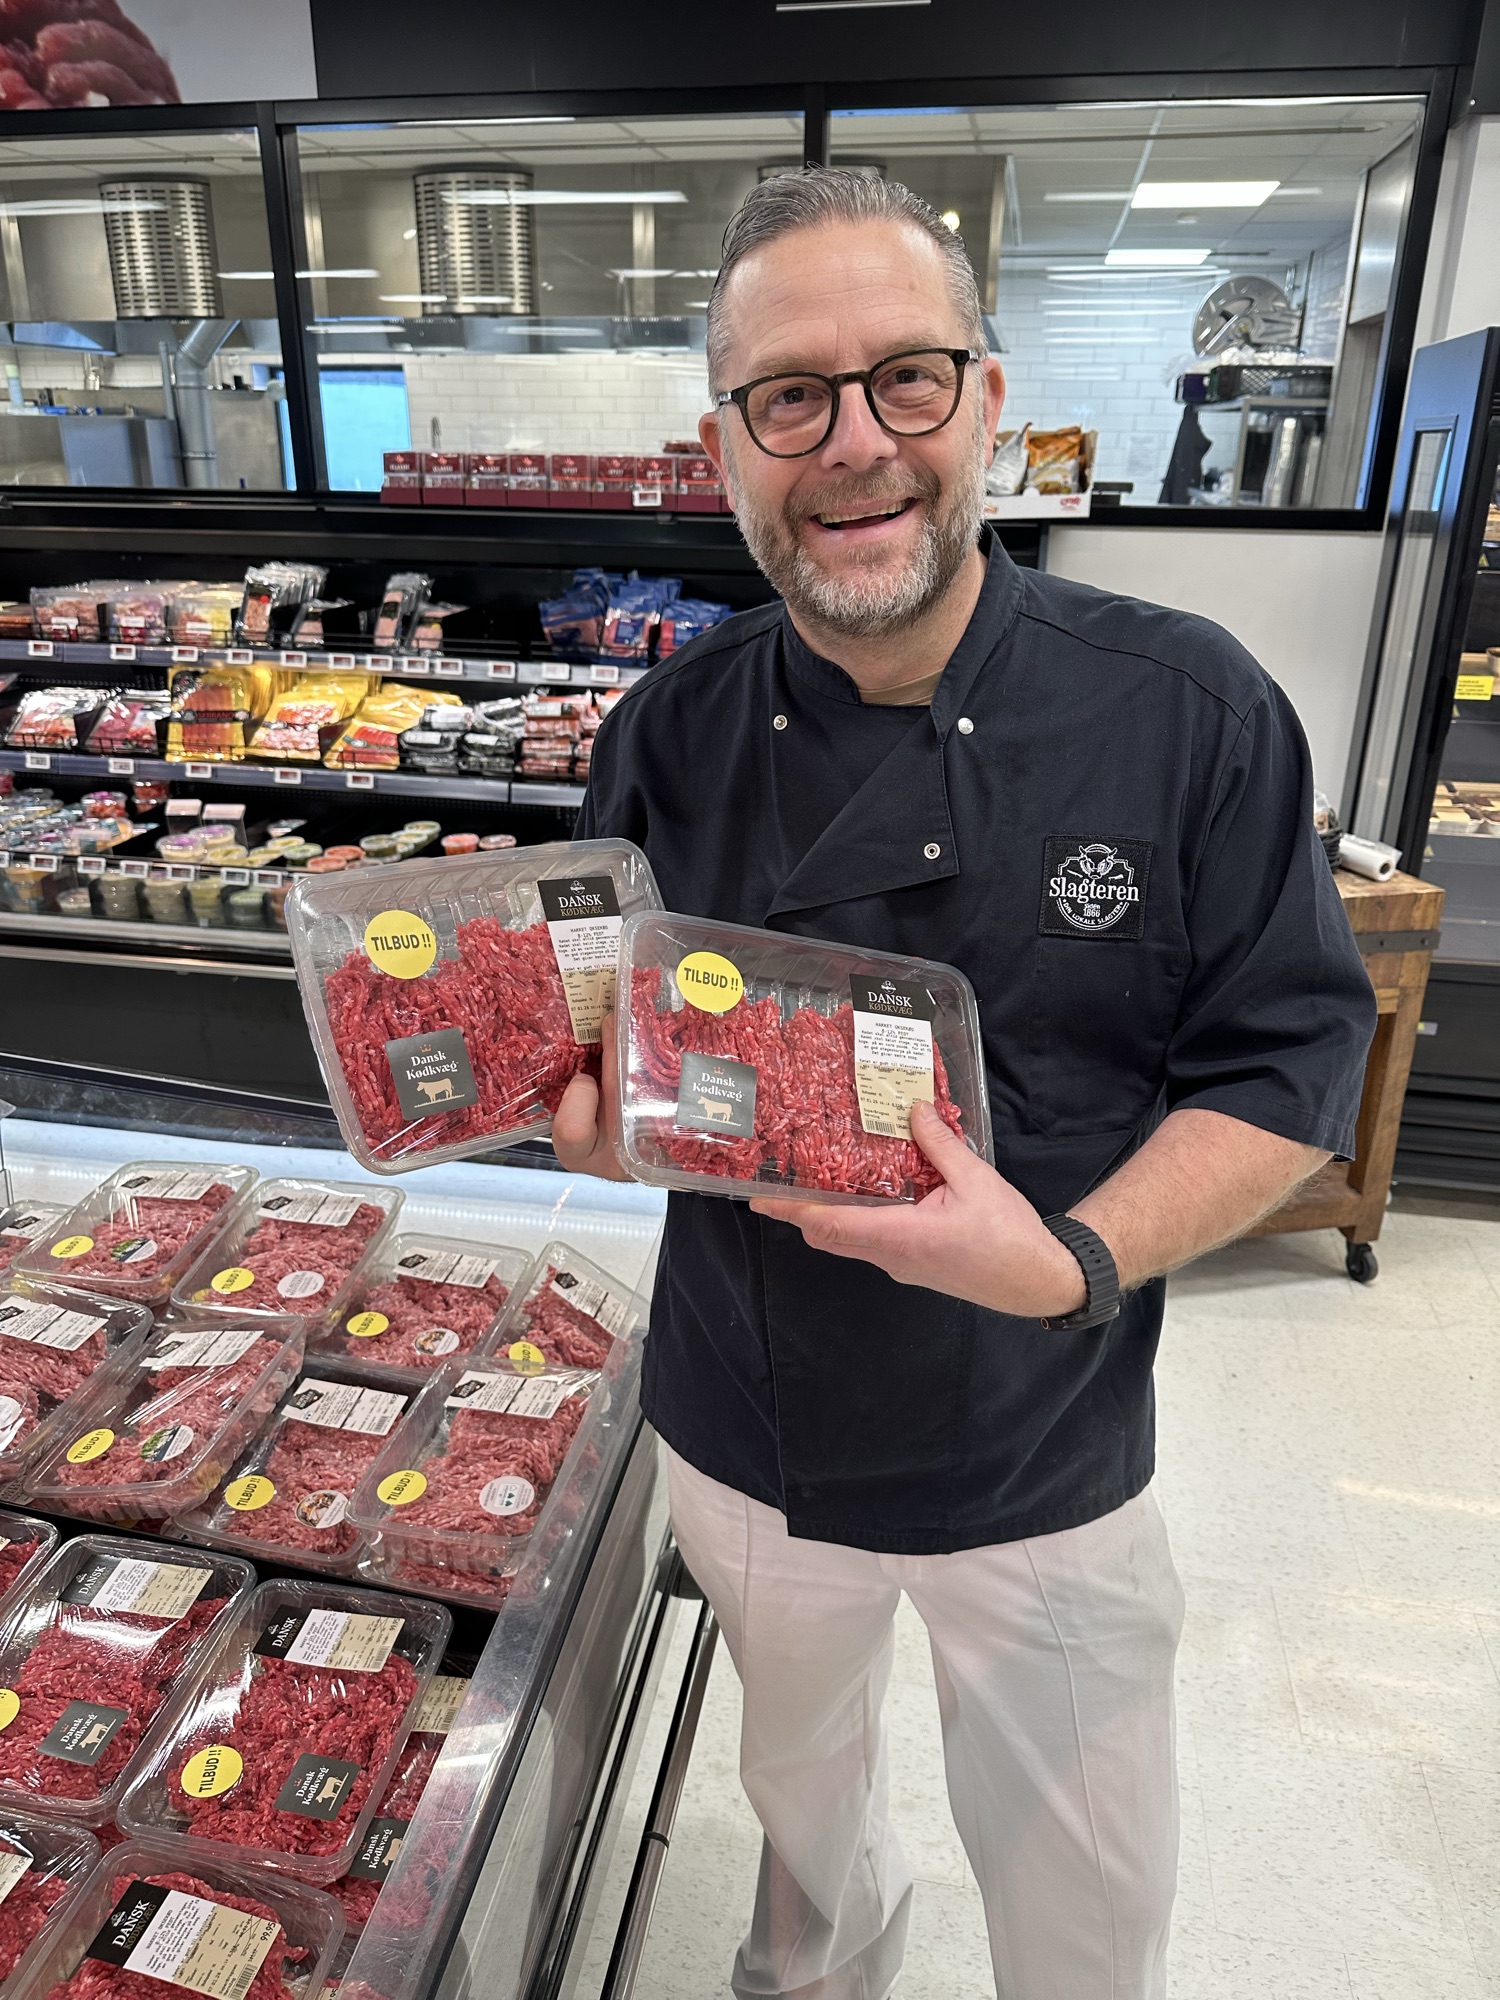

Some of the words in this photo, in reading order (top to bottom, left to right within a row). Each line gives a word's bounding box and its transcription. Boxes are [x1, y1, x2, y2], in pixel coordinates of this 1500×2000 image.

[558, 893, 603, 908] DANSK
[1049, 877, 1139, 903] Slagteren
[560, 906, 605, 917] KØDKVÆG
[1063, 902, 1072, 914] DIN
[1072, 913, 1096, 925] LOKALE
[1097, 905, 1122, 924] SLAGTER
[1083, 908, 1101, 917] 1866
[371, 934, 420, 951] TILBUD
[423, 933, 432, 949] !!
[684, 967, 728, 989] TILBUD
[730, 977, 739, 992] !!
[867, 991, 912, 1007] DANSK
[868, 1002, 913, 1015] KØDKVÆG
[411, 1050, 447, 1067] Dansk
[406, 1061, 458, 1081] Kødkvæg
[701, 1072, 736, 1088] Dansk
[692, 1082, 743, 1102] Kødkvæg
[222, 1273, 240, 1290] TILBUD
[356, 1317, 374, 1334] TILBUD
[74, 1436, 99, 1460] TILBUD
[236, 1483, 257, 1506] TILBUD
[386, 1477, 410, 1501] TILBUD
[77, 1565, 107, 1594] DANSK
[271, 1616, 297, 1646] DANSK
[60, 1717, 84, 1743] Dansk
[65, 1713, 98, 1751] Kødkvæg
[198, 1757, 219, 1793] TILBUD
[295, 1770, 316, 1798] Dansk
[301, 1766, 330, 1806] Kødkvæg
[362, 1833, 380, 1861] Dansk
[368, 1827, 393, 1869] Kødkvæg
[111, 1898, 150, 1947] DANSK
[123, 1903, 157, 1949] KØDKVÆG
